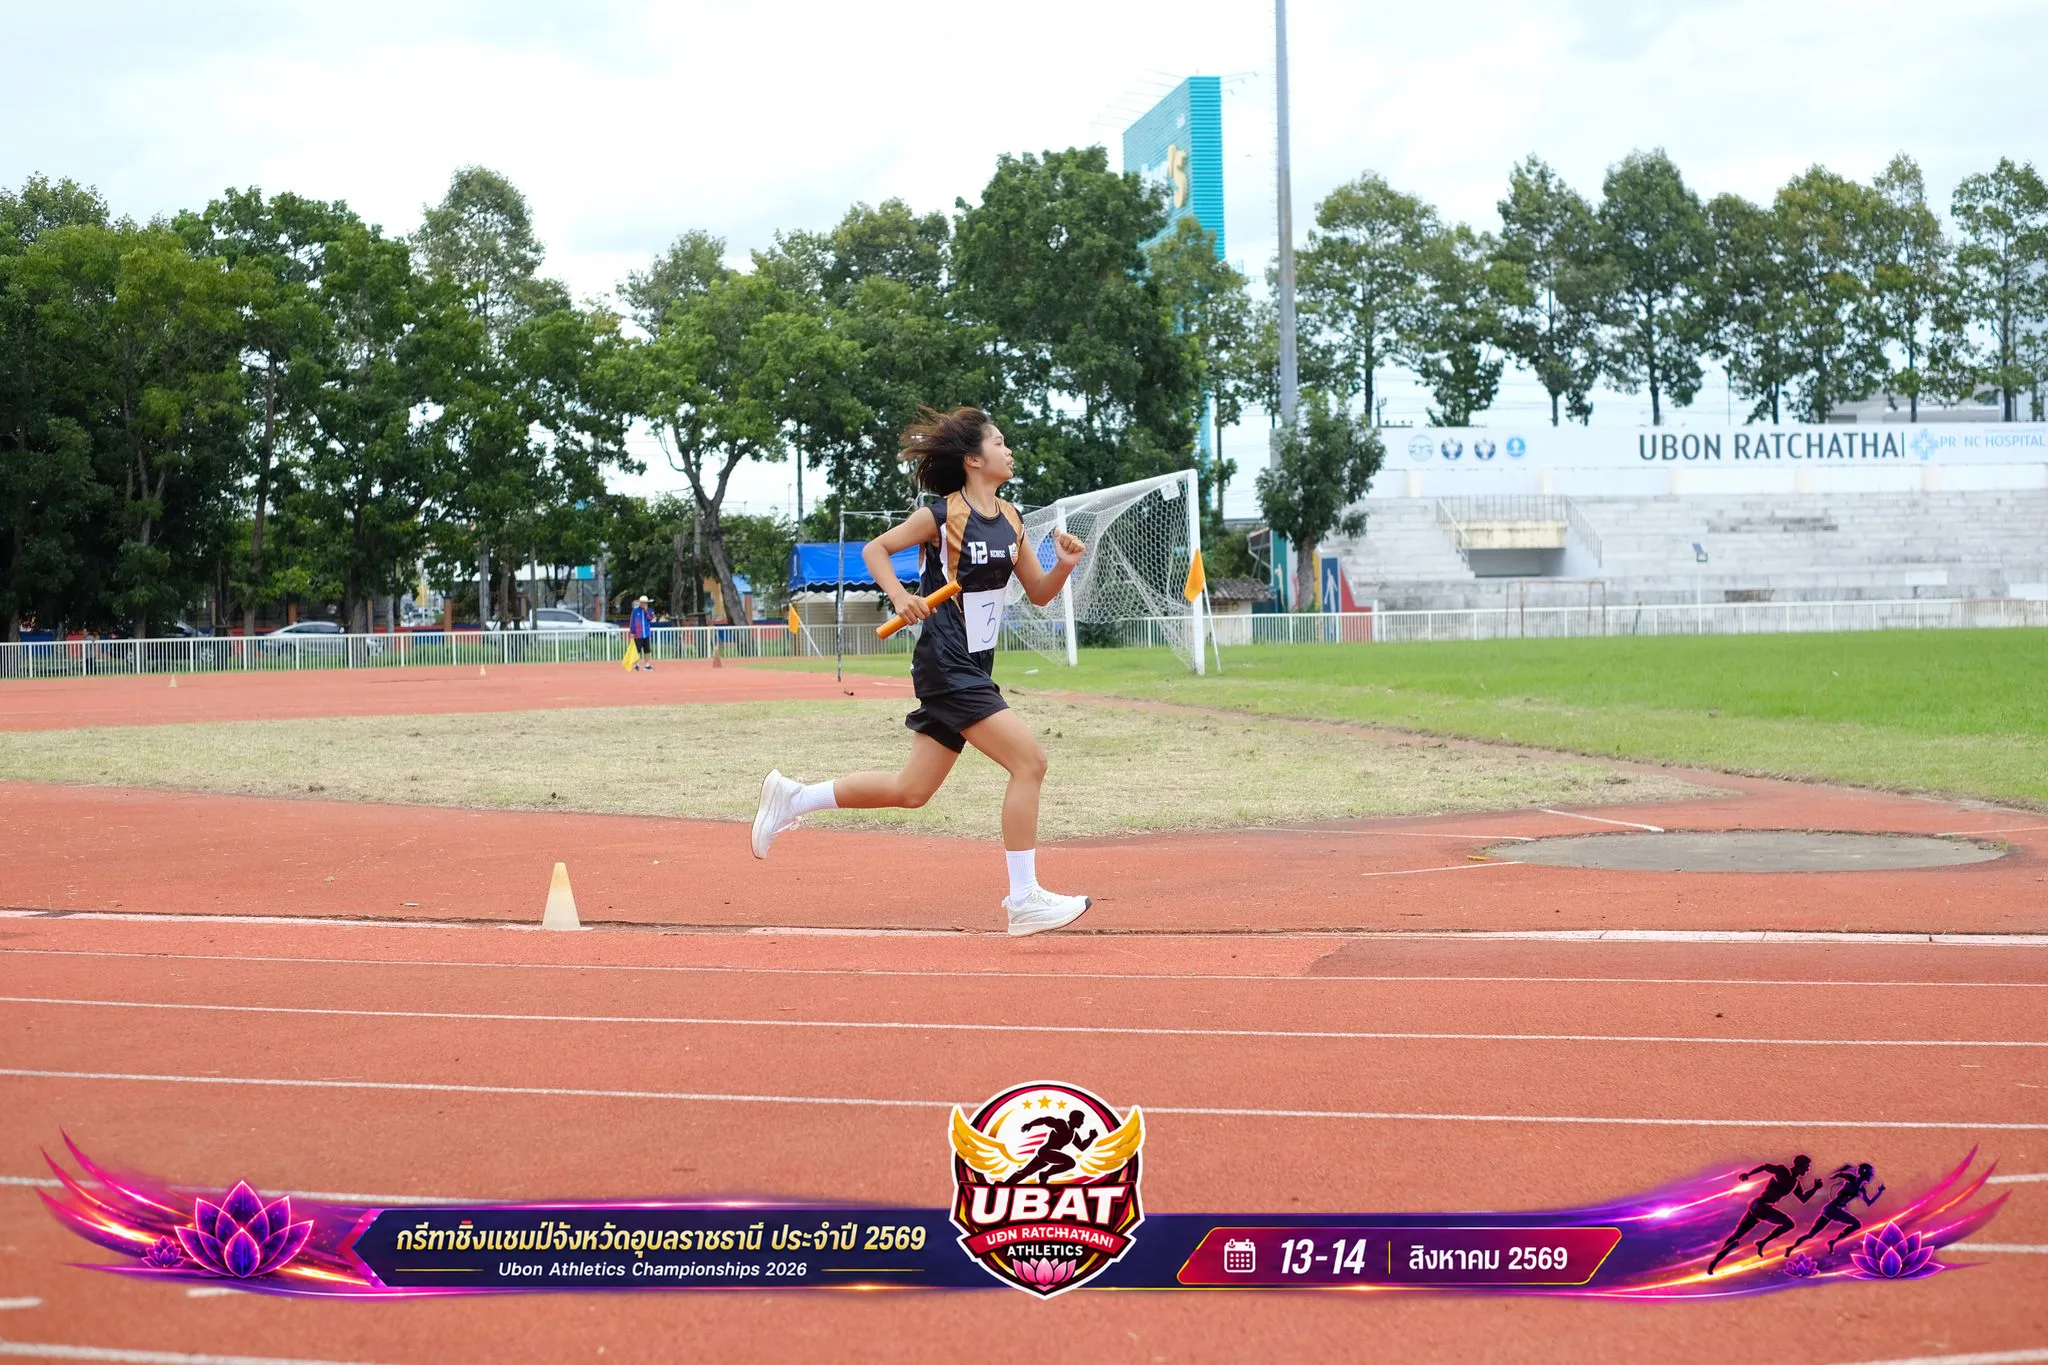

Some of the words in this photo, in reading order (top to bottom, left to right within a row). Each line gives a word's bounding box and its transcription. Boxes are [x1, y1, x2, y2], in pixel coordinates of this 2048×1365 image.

[1639, 434, 1721, 460] UBON
[1985, 434, 2046, 447] HOSPITAL
[967, 541, 988, 565] 12
[982, 601, 997, 643] 3
